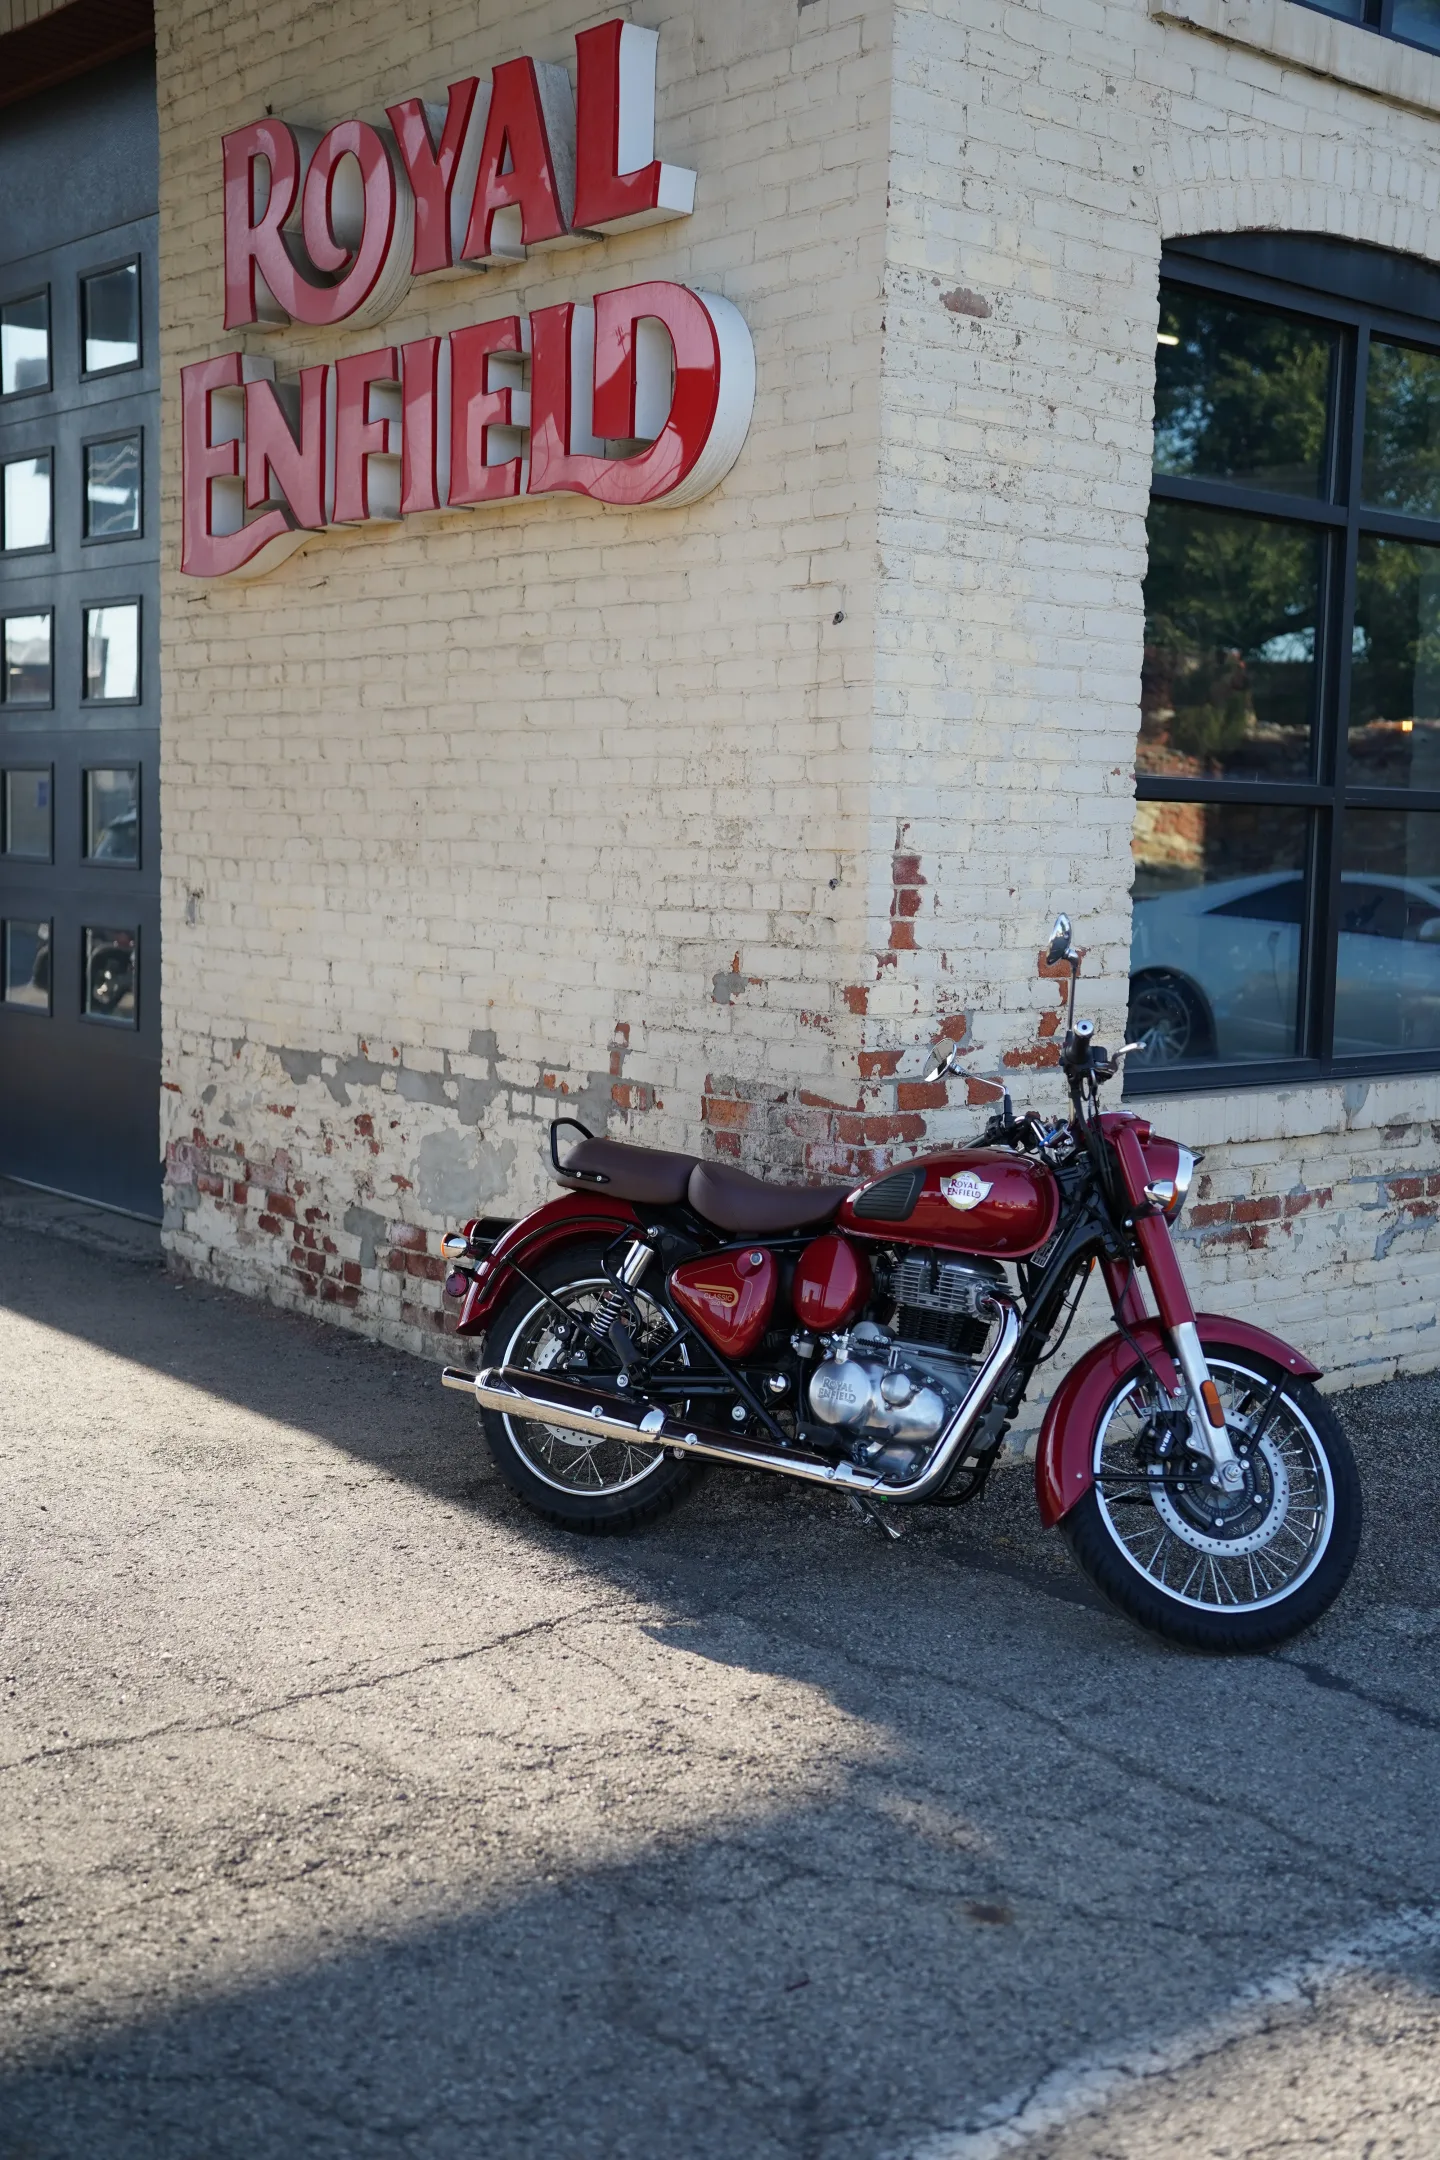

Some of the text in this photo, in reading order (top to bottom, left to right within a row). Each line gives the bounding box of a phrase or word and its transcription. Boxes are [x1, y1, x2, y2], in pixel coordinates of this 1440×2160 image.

[222, 18, 697, 332] ROYAL
[180, 281, 756, 578] ENFIELD
[951, 1179, 978, 1189] ROYAL
[947, 1188, 982, 1198] ENFIELD
[703, 1292, 733, 1302] CLASSIC
[822, 1376, 853, 1392] ROYAL
[818, 1388, 857, 1404] ENFIELD
